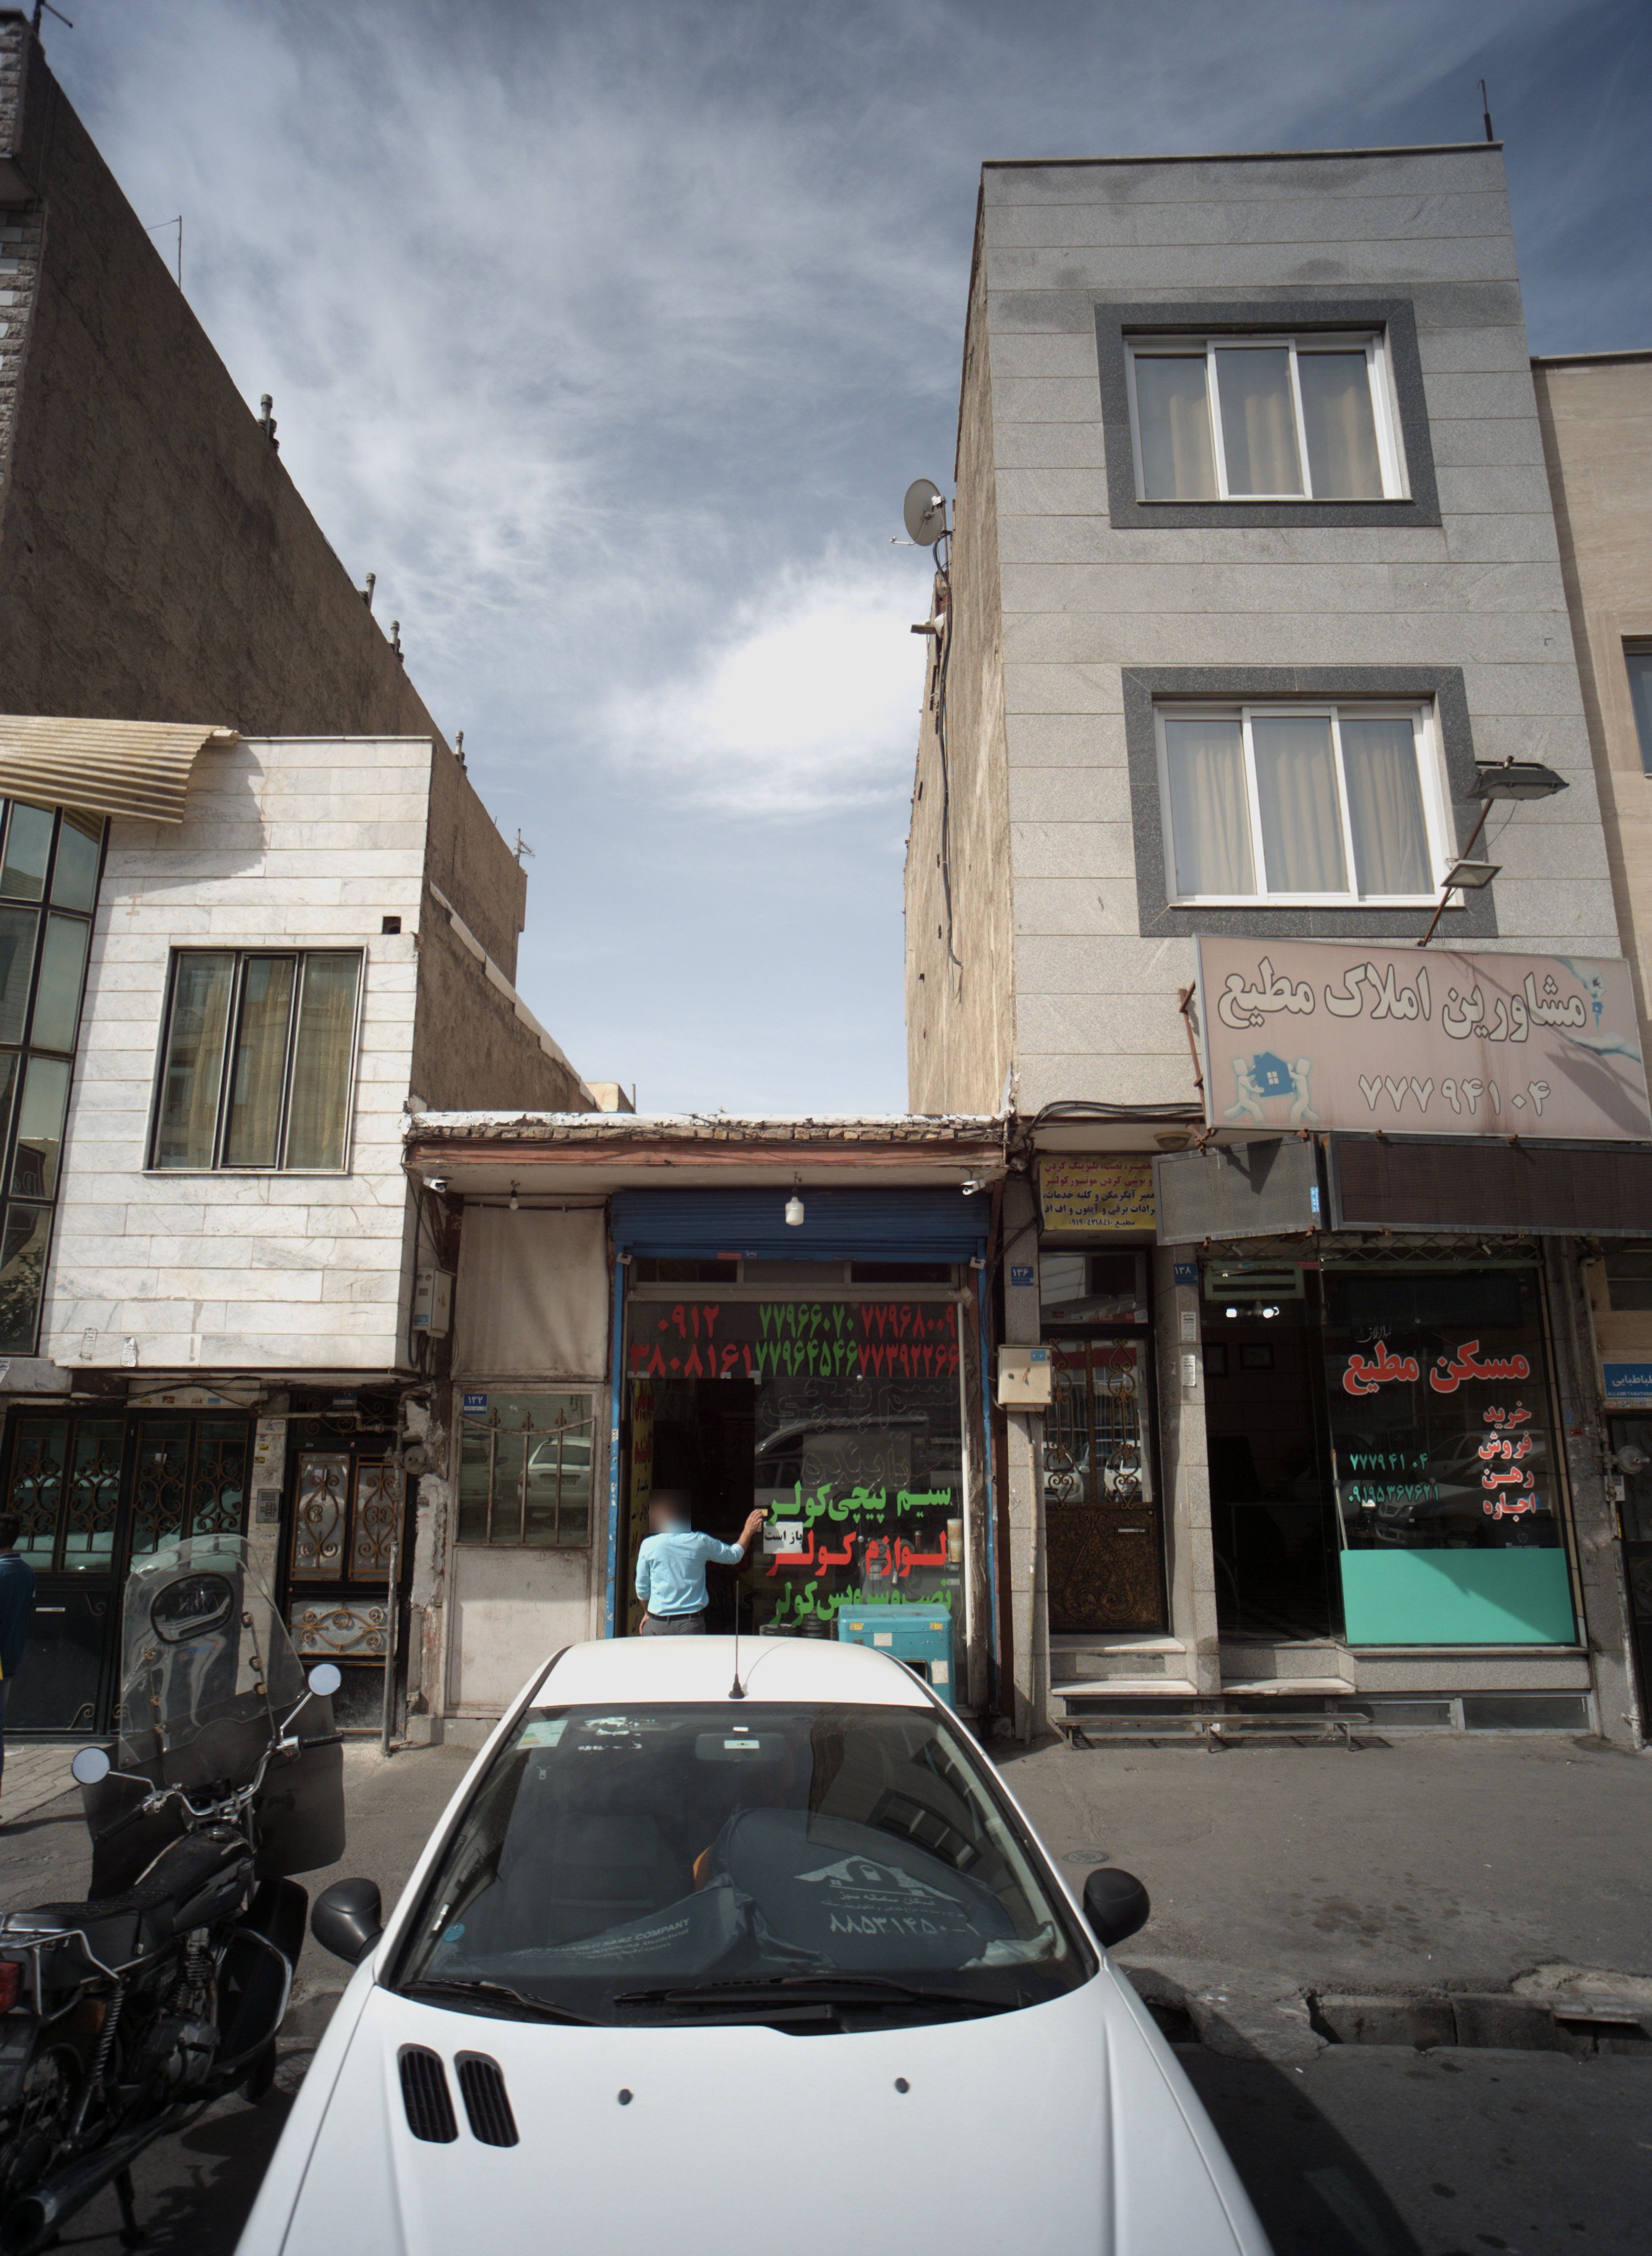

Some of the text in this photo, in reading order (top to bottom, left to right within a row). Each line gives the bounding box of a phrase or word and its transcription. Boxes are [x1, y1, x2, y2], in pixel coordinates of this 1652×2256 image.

[1218, 956, 1587, 1042] مشاورین املاک مطیع
[1044, 1161, 1066, 1173] کردن
[1045, 1175, 1069, 1187] کولر
[1100, 1175, 1122, 1186] کردن
[1108, 1204, 1128, 1216] برقی
[1115, 1219, 1135, 1228] مطیع
[1013, 1268, 1029, 1277] ۱۳۶
[1175, 1266, 1192, 1275] ۱۳۸
[657, 1304, 720, 1339] ۰۹۱۲
[759, 1303, 855, 1340] ۷۷۹۶۶۰۷۰
[861, 1303, 956, 1340] ۷۷۹۶۸۰۰۹
[629, 1342, 752, 1378] ۳۸۰۸۱۶۱
[755, 1339, 858, 1377] ۷۷۹۶۴۵۴۶
[857, 1342, 959, 1379] ۷۷۳۹۲۲۶۶
[1343, 1340, 1530, 1396] مسکن مطیع
[1612, 1375, 1652, 1387] باطبایی
[468, 1396, 483, 1404] ۱۳۲
[1483, 1400, 1532, 1429] خرید
[1478, 1431, 1533, 1460] فروش
[1481, 1466, 1535, 1490] رهن
[766, 1480, 952, 1528] سیم پیچی کولر
[1347, 1483, 1439, 1503] ۰۹۱۹۵۳۶۷۶۲۱
[1482, 1492, 1536, 1523] اجاره
[765, 1530, 802, 1544] باز است
[765, 1529, 947, 1577] لوازم کولر
[769, 1580, 818, 1626] کولر
[634, 1917, 690, 1940] COMPANY
